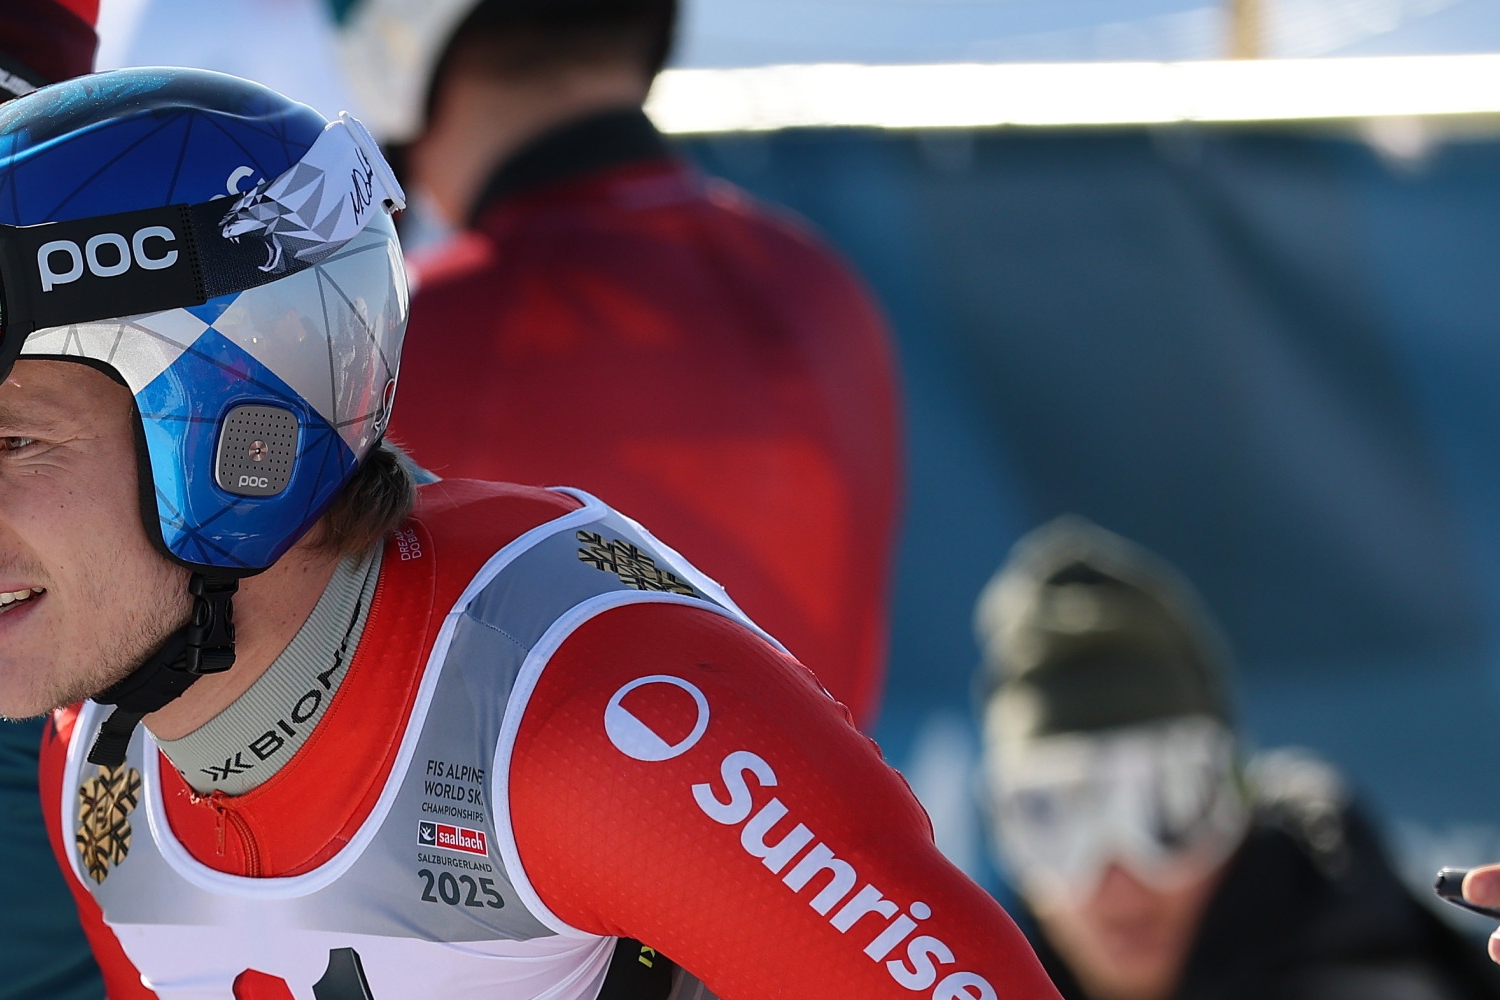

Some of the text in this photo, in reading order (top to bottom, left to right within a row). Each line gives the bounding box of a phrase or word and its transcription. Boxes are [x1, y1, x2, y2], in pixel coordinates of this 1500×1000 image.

[426, 759, 485, 786] FIS ALPINE
[424, 780, 484, 806] WORLD SK
[421, 802, 484, 823] CHAMPIONSHIPS
[439, 826, 484, 850] saalbach
[417, 853, 493, 873] SALZBURGERLAND
[417, 868, 505, 909] 2025
